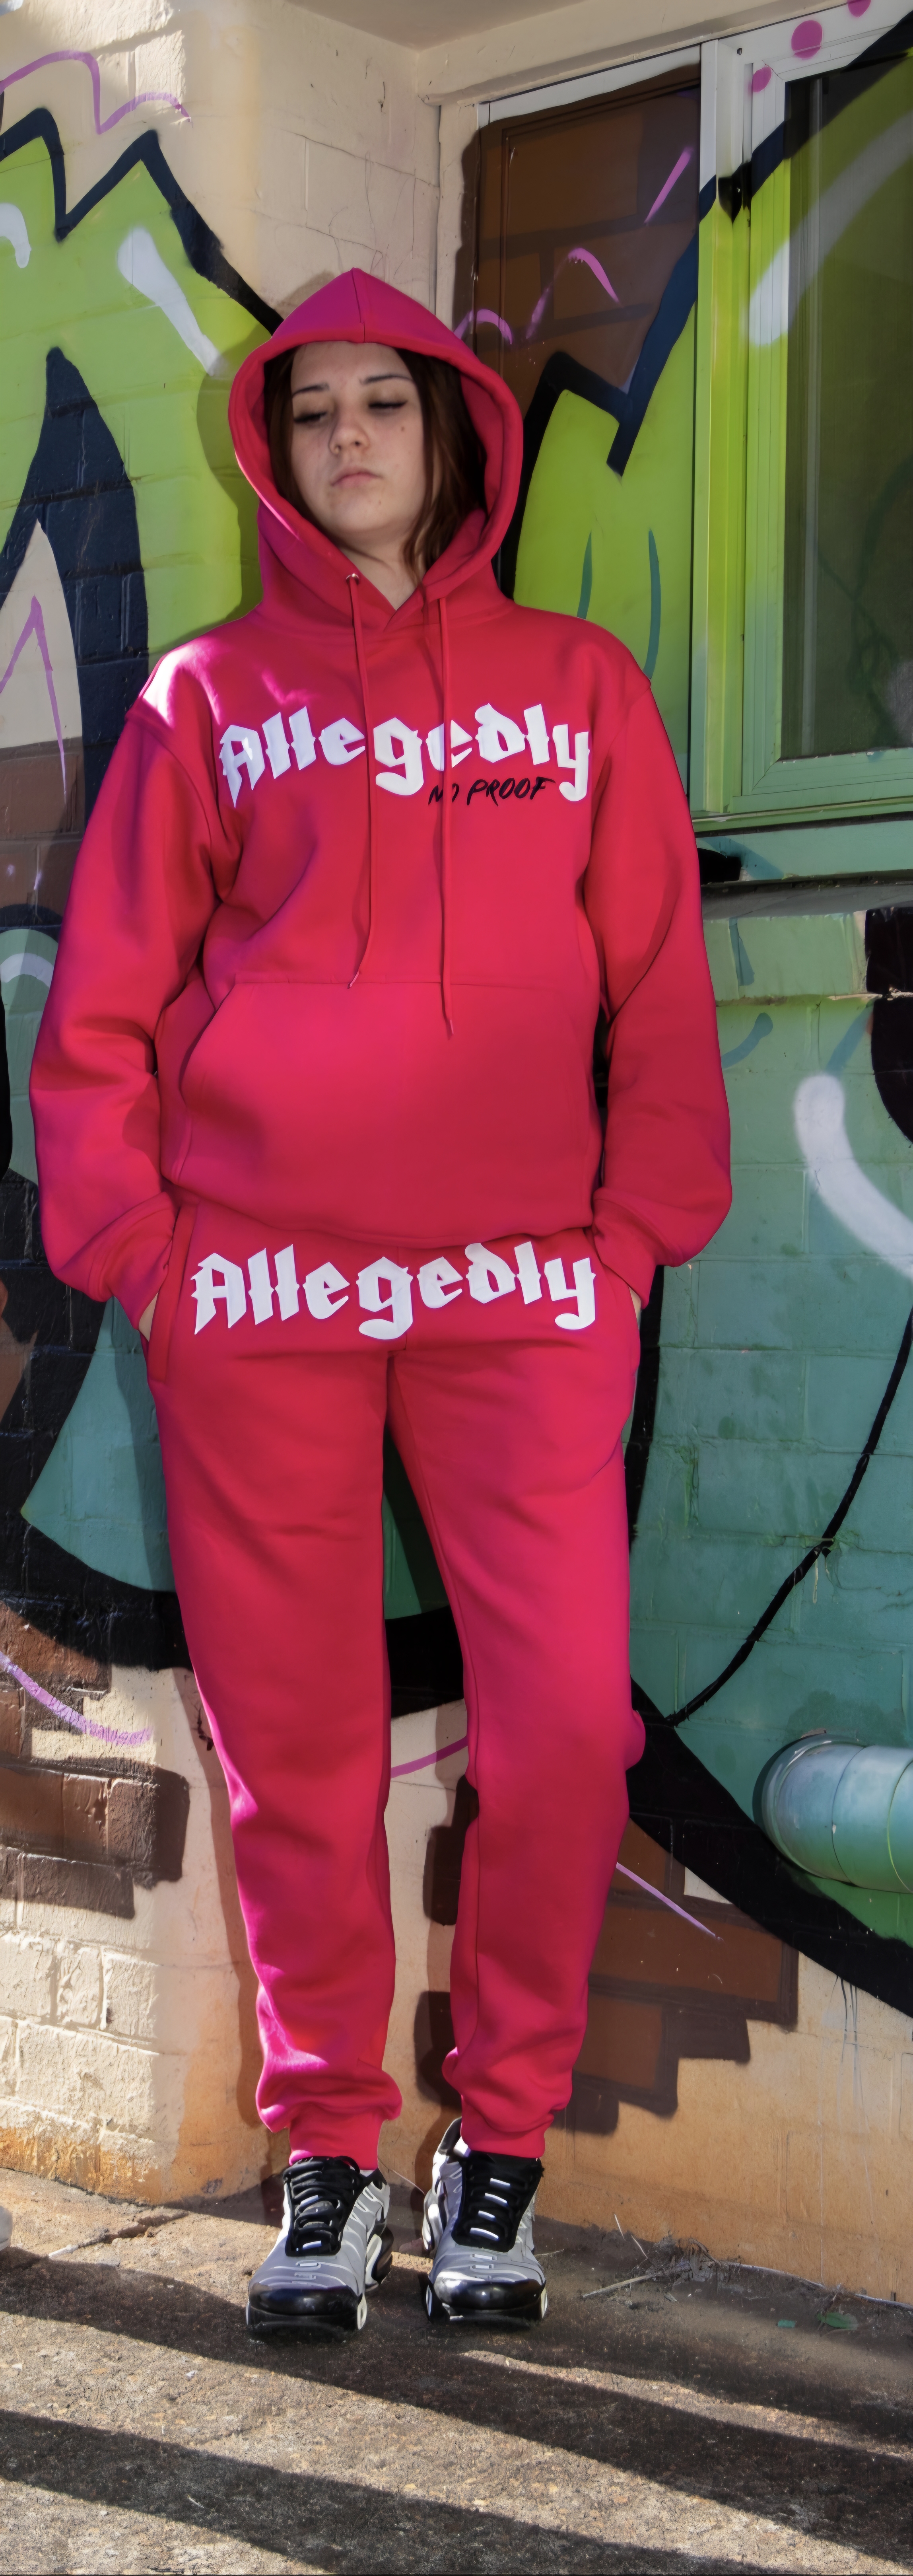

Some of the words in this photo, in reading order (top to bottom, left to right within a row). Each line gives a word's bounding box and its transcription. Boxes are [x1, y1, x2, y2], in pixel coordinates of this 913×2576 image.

[219, 703, 590, 807] Allegedly
[466, 776, 556, 806] PROOF
[191, 1241, 596, 1340] Allegedly
